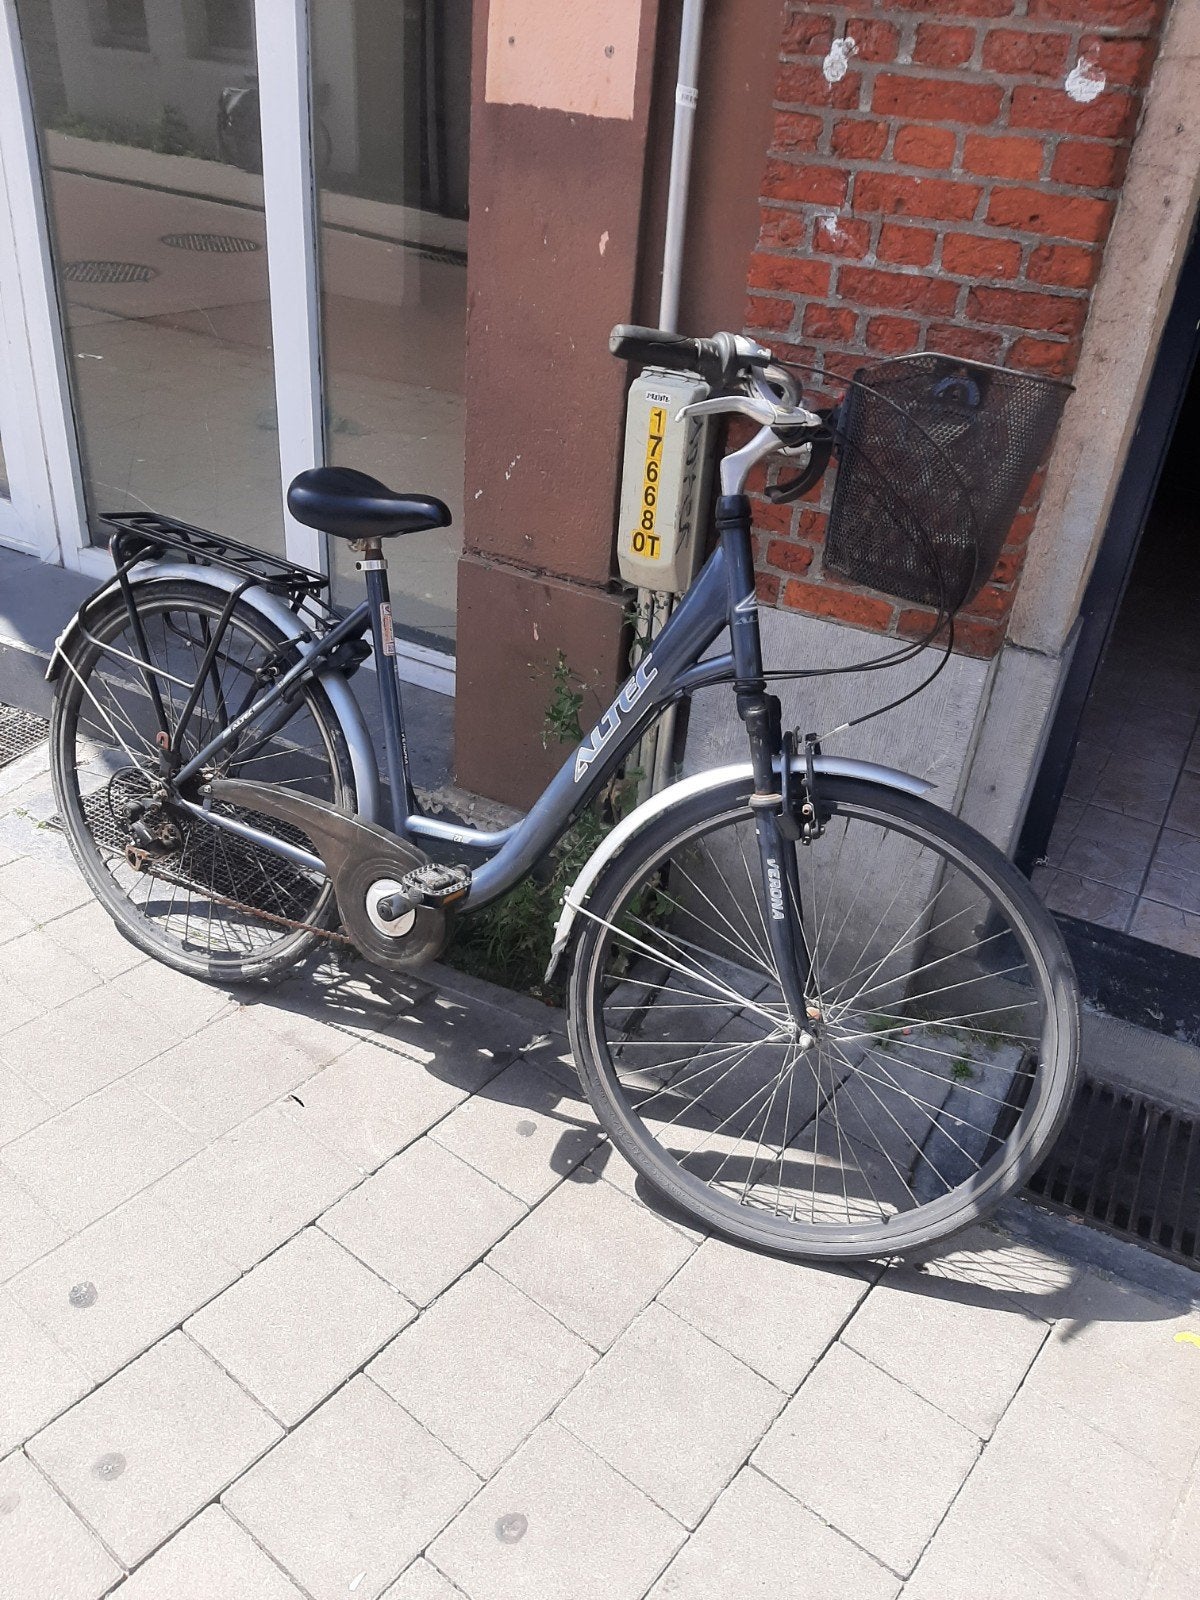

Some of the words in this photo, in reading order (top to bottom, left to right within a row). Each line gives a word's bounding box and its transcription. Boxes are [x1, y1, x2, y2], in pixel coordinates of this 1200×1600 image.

[231, 708, 255, 731] ALTEC
[574, 652, 658, 783] ALTEC
[766, 858, 785, 920] VERONA
